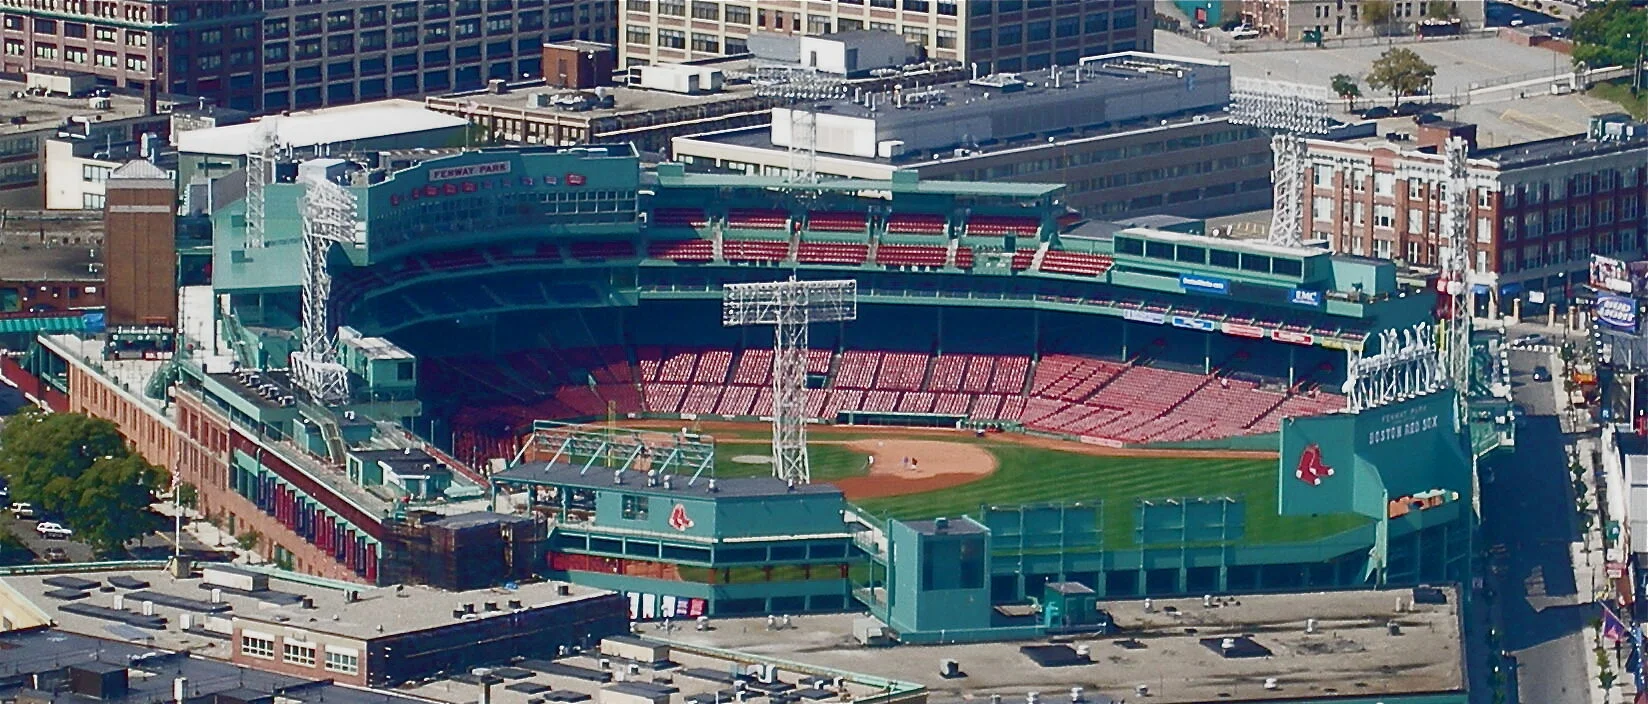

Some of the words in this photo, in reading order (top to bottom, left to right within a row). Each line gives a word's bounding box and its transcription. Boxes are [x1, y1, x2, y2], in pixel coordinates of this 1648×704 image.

[434, 167, 474, 178] FENWAY
[480, 163, 506, 173] PARK
[1604, 300, 1631, 312] BUD
[1369, 426, 1402, 445] BOSTON
[1404, 420, 1420, 436] RED
[1422, 415, 1438, 431] SOX
